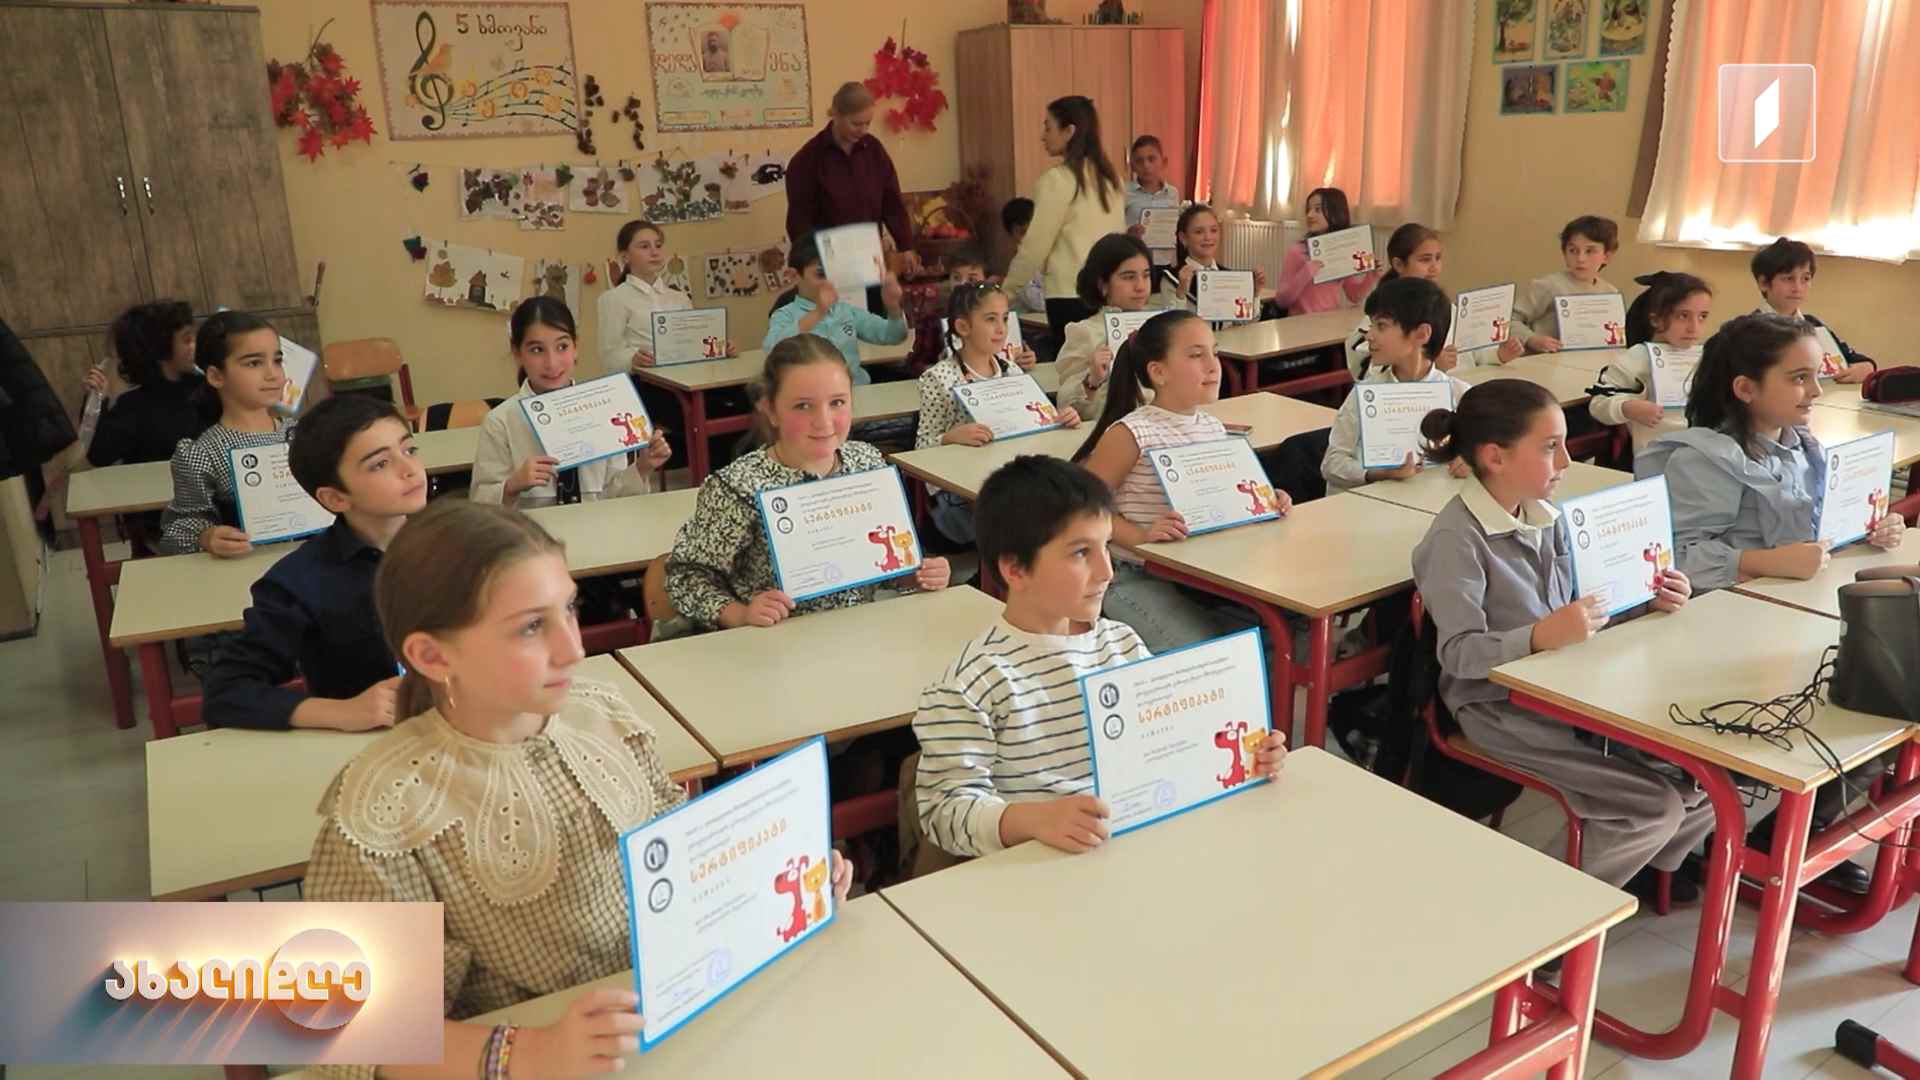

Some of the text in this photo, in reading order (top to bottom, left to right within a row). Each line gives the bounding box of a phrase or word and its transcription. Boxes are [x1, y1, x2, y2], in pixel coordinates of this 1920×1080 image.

[456, 13, 547, 52] 5 ხმოვანი
[768, 51, 801, 72] ენა
[1138, 688, 1224, 723] სერტიფიკატი
